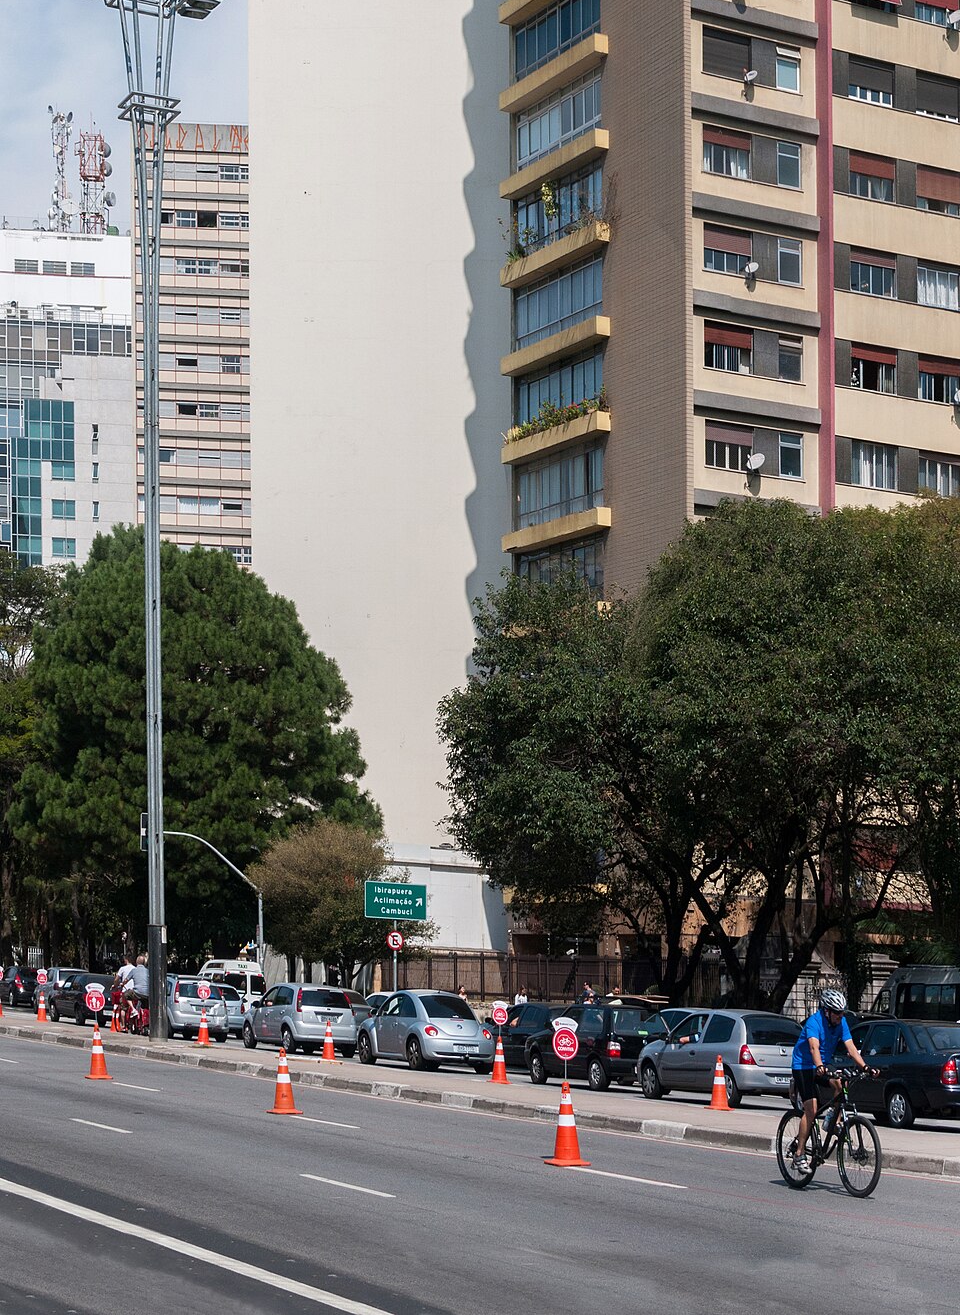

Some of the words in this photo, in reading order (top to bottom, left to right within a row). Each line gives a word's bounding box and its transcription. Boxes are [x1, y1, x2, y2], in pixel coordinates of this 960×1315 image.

[374, 886, 413, 895] Ibirapuera
[373, 896, 413, 906] Aclimação
[380, 906, 413, 915] Cambuci
